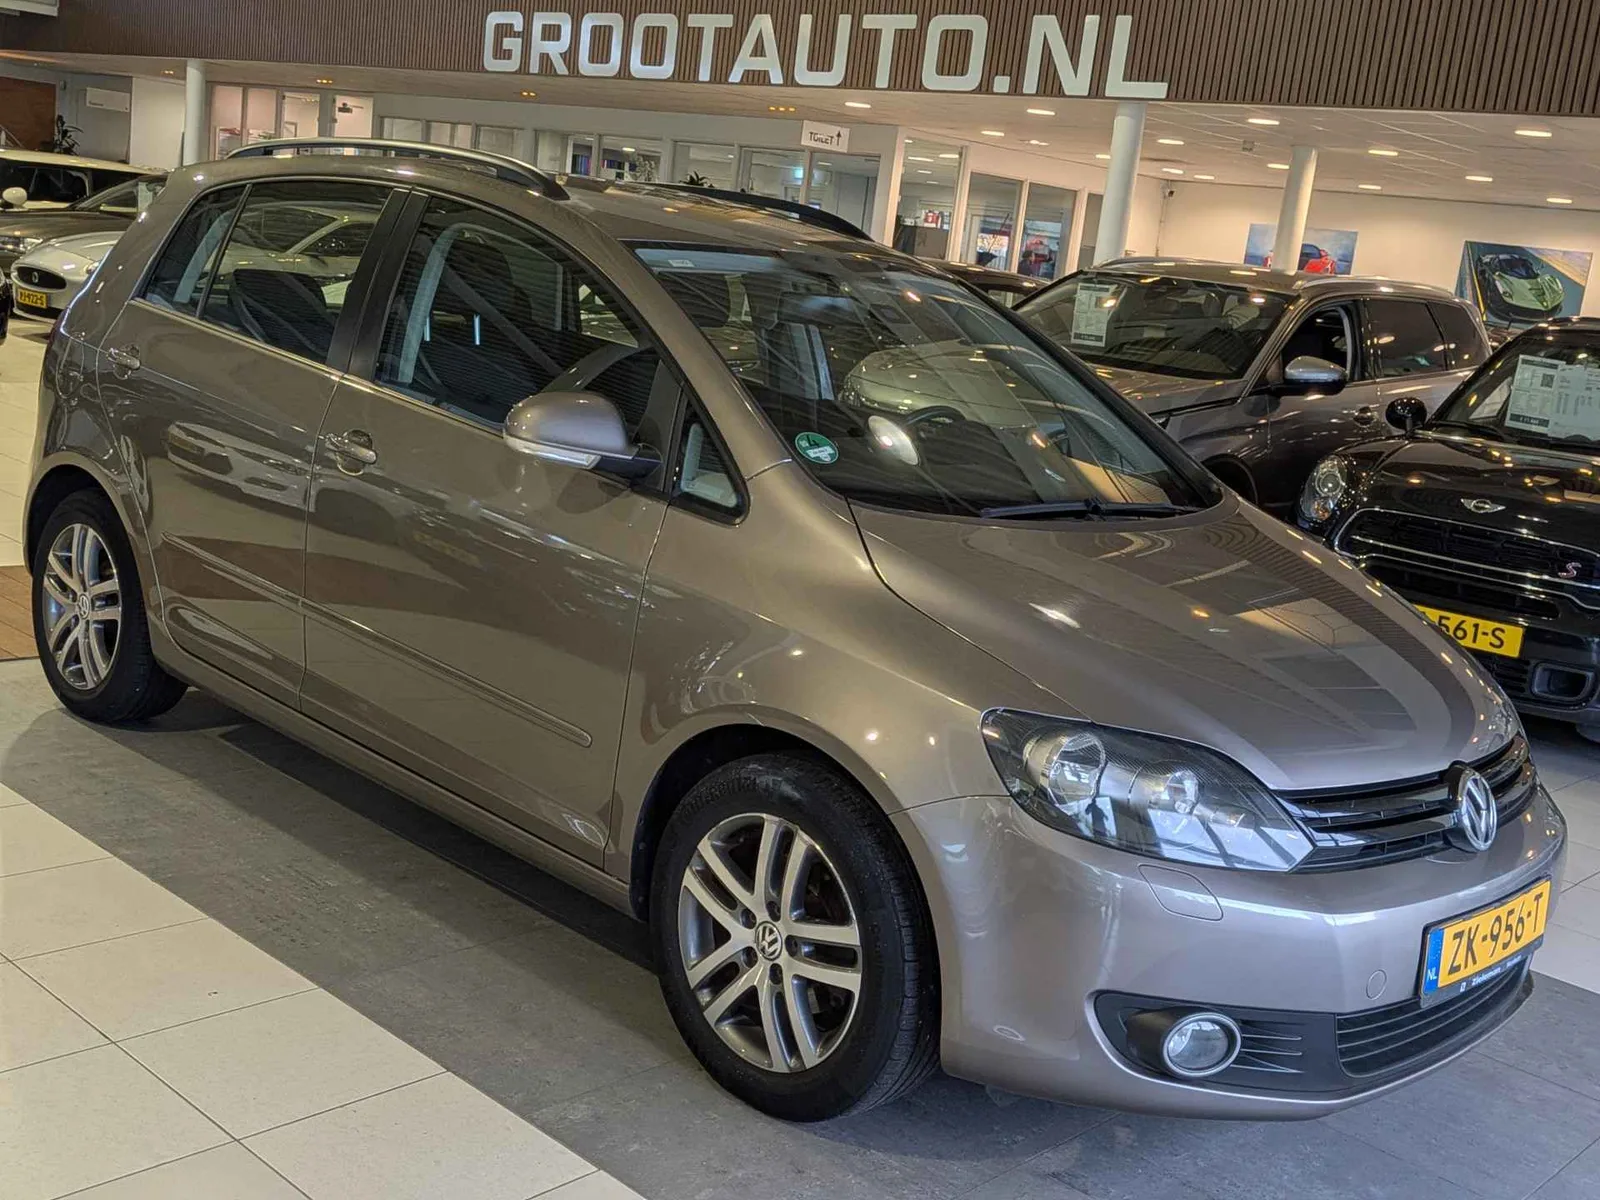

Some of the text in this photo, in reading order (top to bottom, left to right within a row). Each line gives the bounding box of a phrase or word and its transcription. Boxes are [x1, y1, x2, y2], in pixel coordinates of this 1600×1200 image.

[483, 10, 1169, 99] GROOTAUTO.NL
[809, 131, 834, 145] TOILET
[806, 434, 820, 447] 4
[1558, 562, 1582, 578] S
[1448, 892, 1543, 975] ZK-956-T
[1427, 967, 1438, 981] NL
